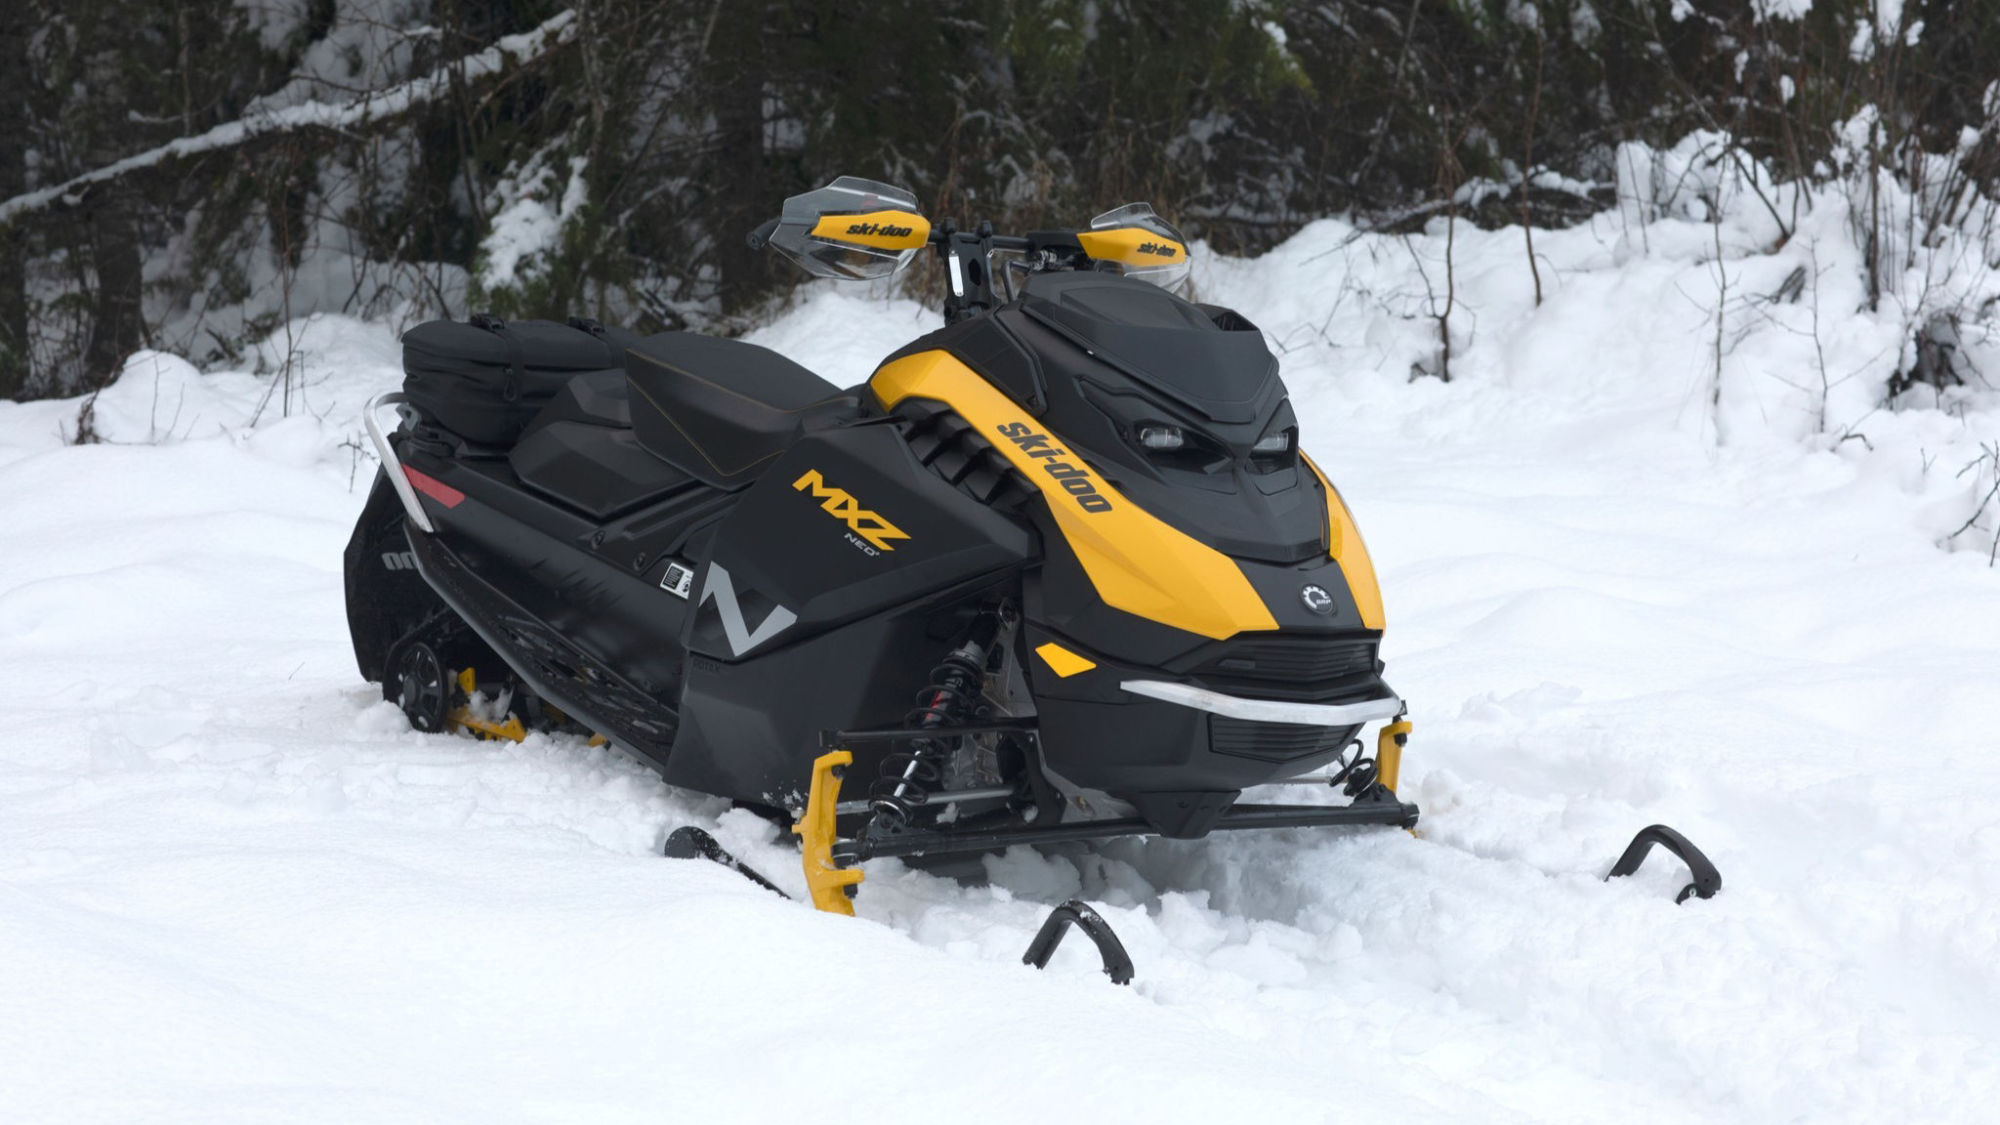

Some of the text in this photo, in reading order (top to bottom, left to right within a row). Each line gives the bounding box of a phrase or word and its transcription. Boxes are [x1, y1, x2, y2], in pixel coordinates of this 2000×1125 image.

[846, 222, 913, 238] ski-doo
[1137, 242, 1177, 257] ski-doo
[996, 422, 1113, 514] ski-doo
[792, 469, 912, 551] MXZ
